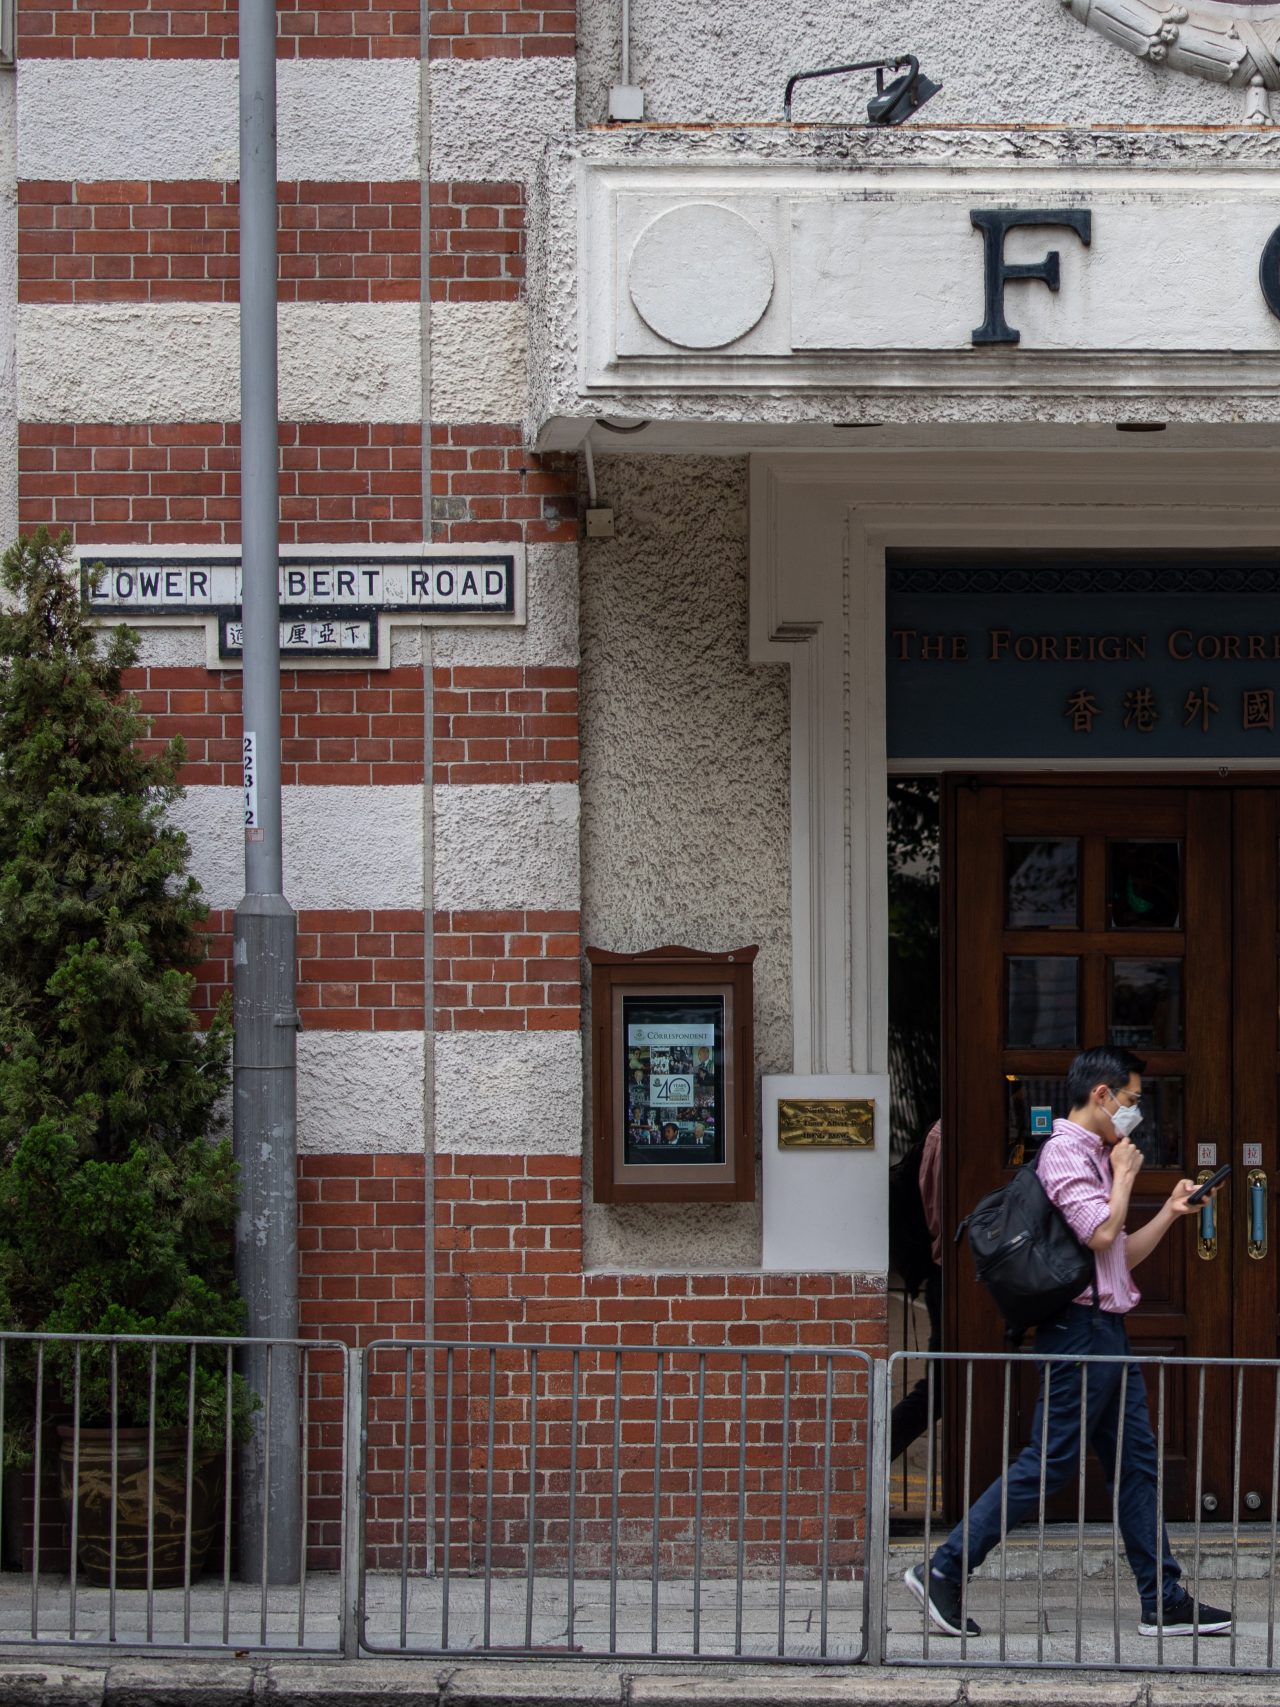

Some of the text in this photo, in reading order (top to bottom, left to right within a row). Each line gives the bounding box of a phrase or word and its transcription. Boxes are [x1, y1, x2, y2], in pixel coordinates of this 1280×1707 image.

[92, 569, 504, 598] LOWER BERT ROAD
[893, 629, 969, 661] THE
[988, 628, 1147, 661] FOREIGN
[244, 738, 254, 825] 22312
